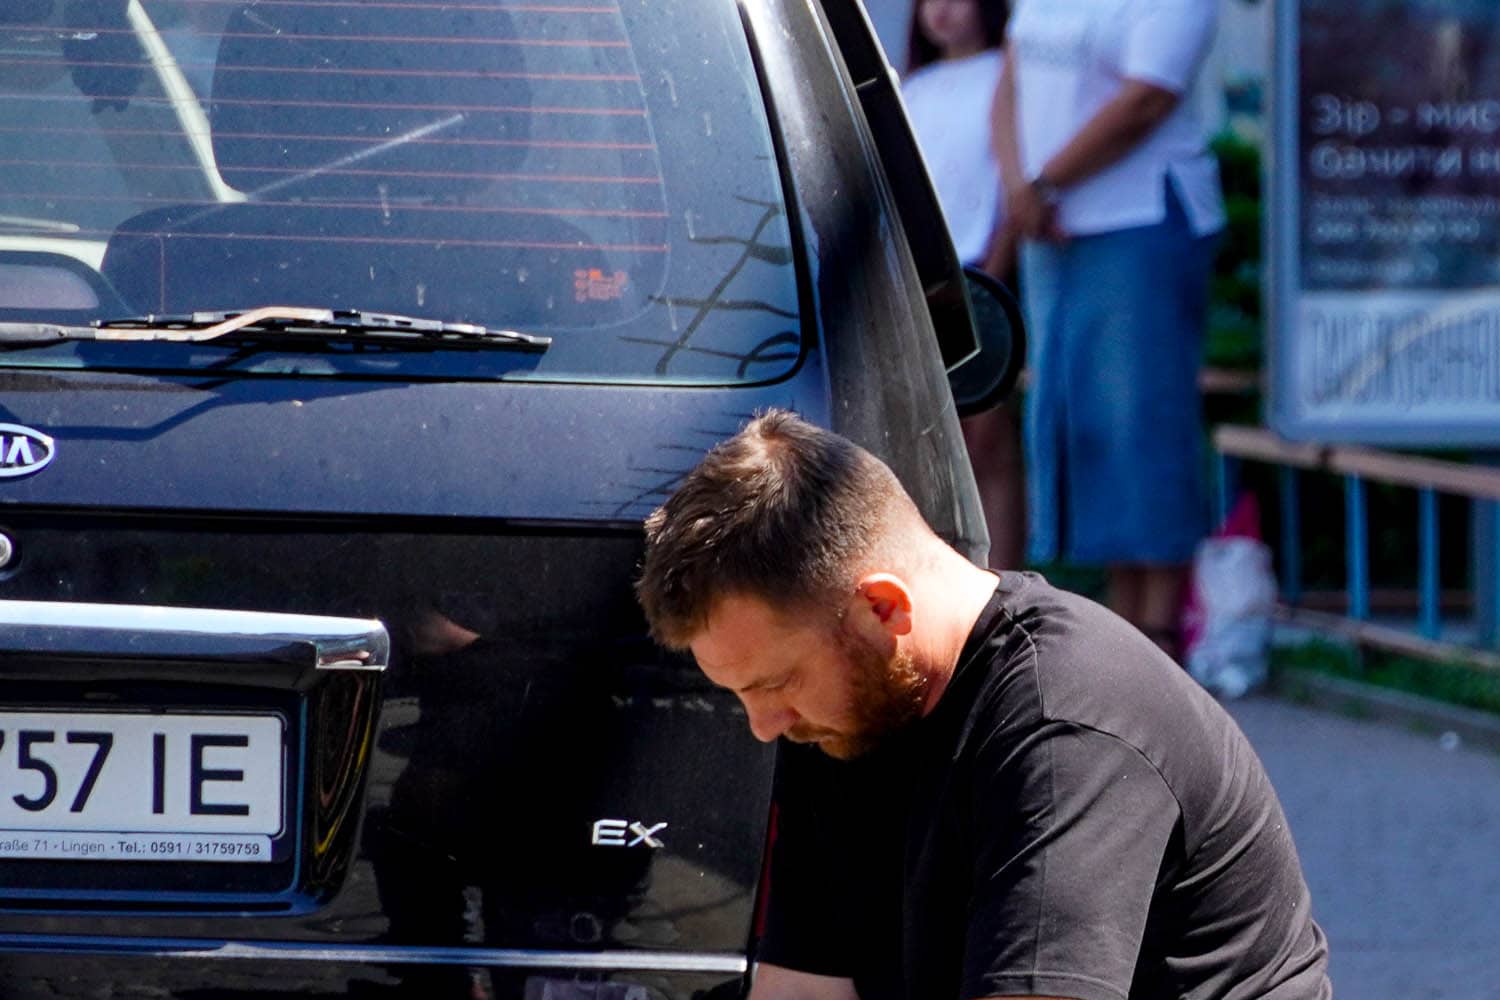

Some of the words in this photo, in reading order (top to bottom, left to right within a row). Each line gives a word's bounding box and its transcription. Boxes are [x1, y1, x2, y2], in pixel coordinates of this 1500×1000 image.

[0, 730, 114, 813] 57
[152, 732, 250, 816] IE
[33, 840, 48, 852] 71
[61, 840, 106, 855] Lingen
[118, 841, 146, 854] Tel.:
[150, 841, 183, 854] 0591
[195, 843, 260, 855] 31759759
[592, 819, 668, 848] EX
